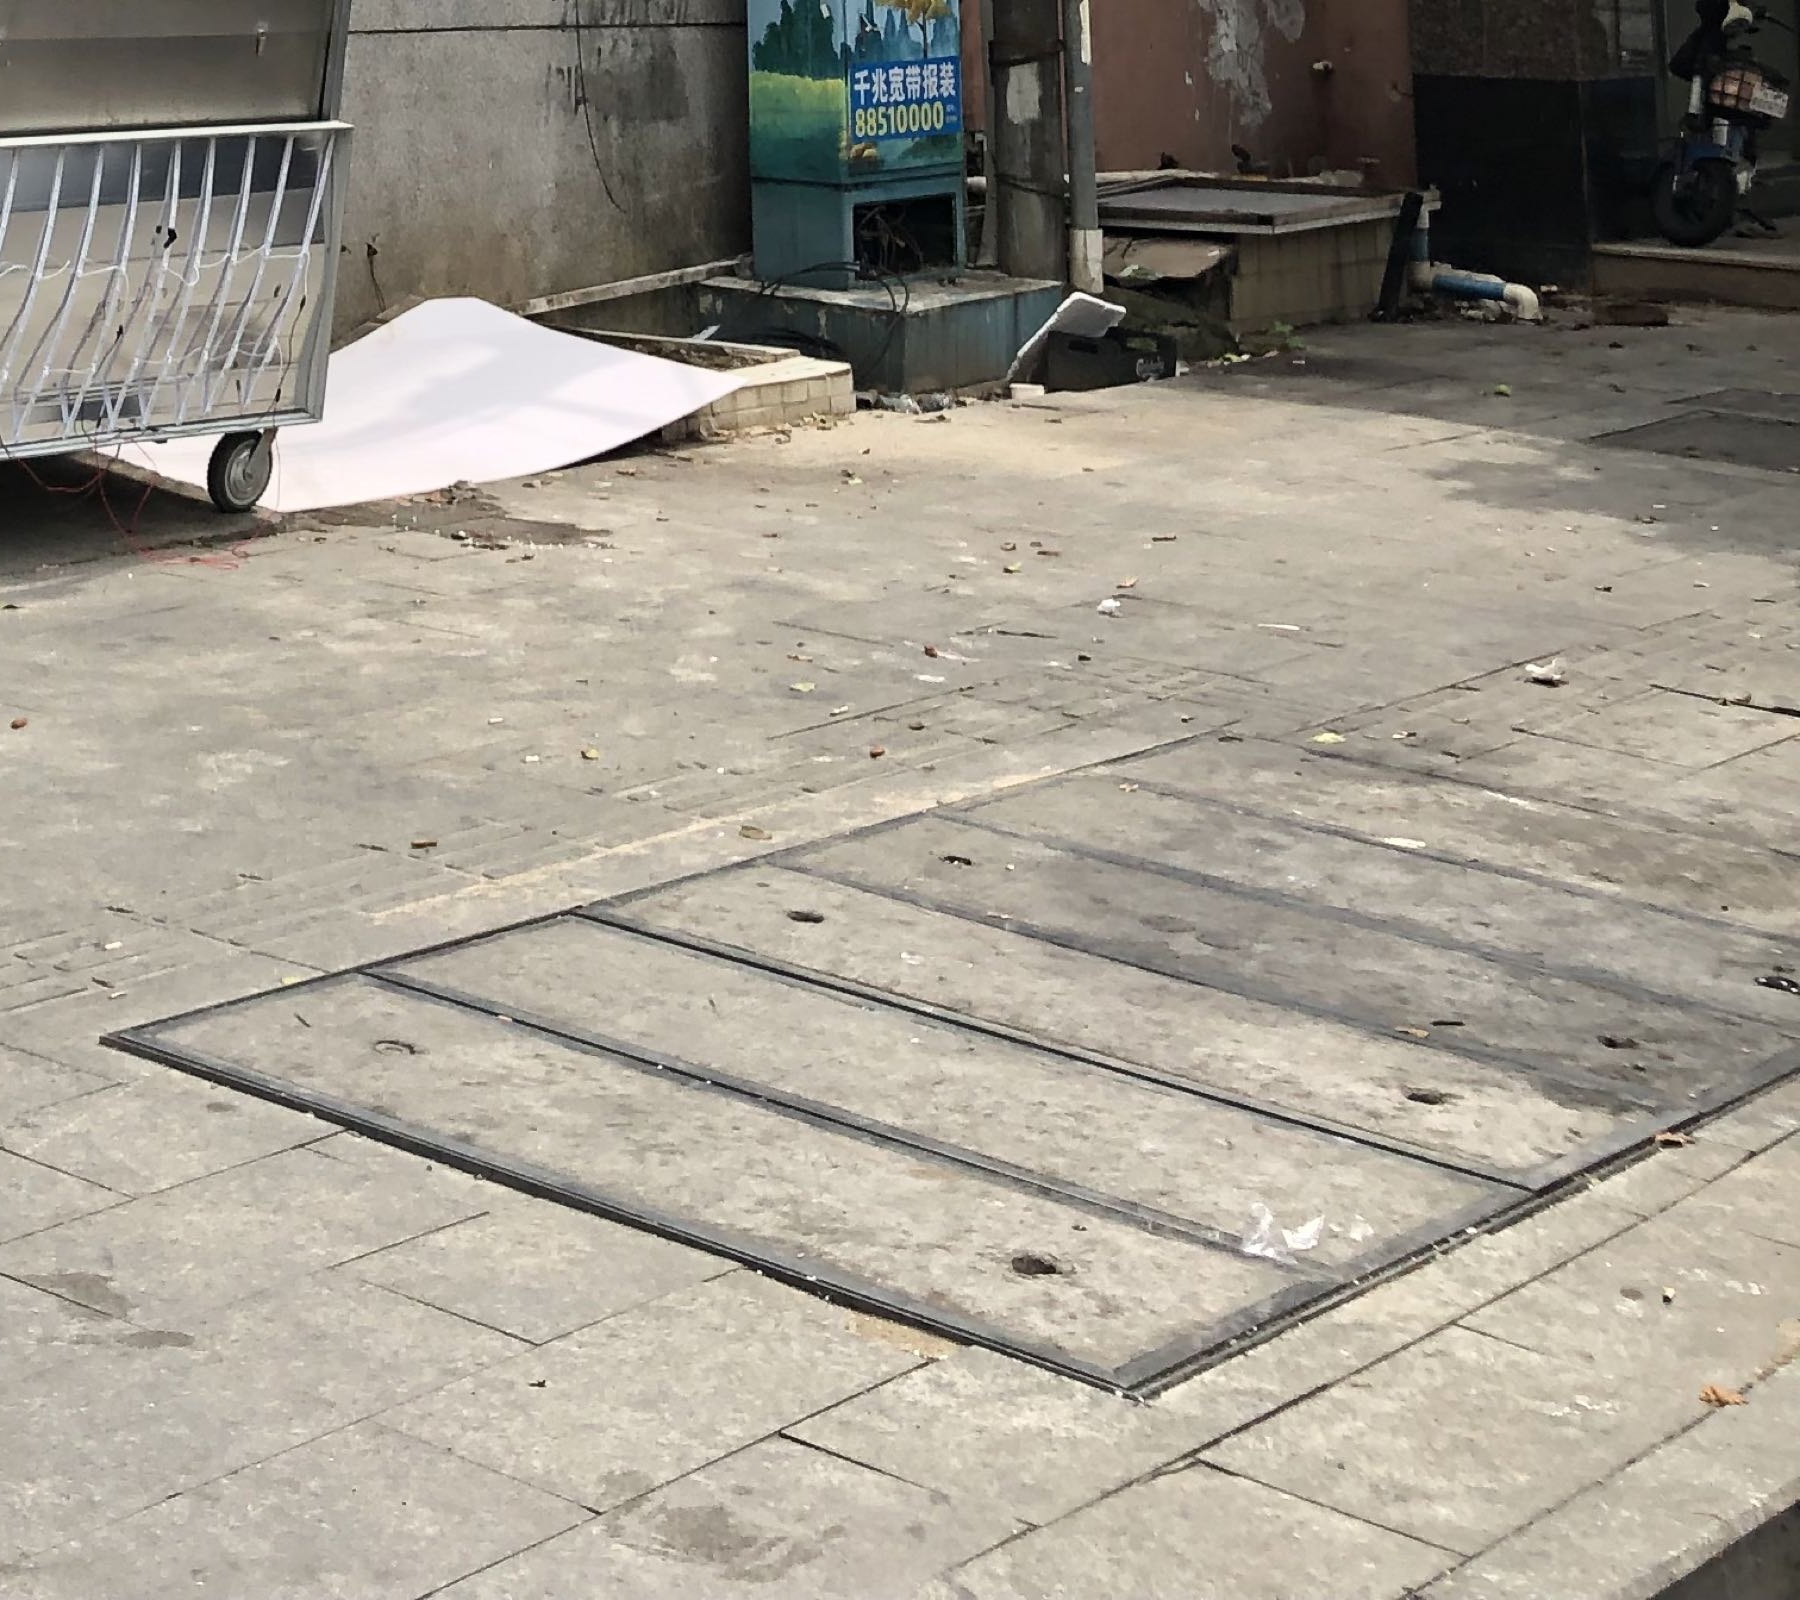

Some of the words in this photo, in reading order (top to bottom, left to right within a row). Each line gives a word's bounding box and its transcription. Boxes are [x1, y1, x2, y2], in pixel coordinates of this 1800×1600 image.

[853, 61, 956, 106] 千兆宽带报装
[854, 100, 945, 138] 88510000
